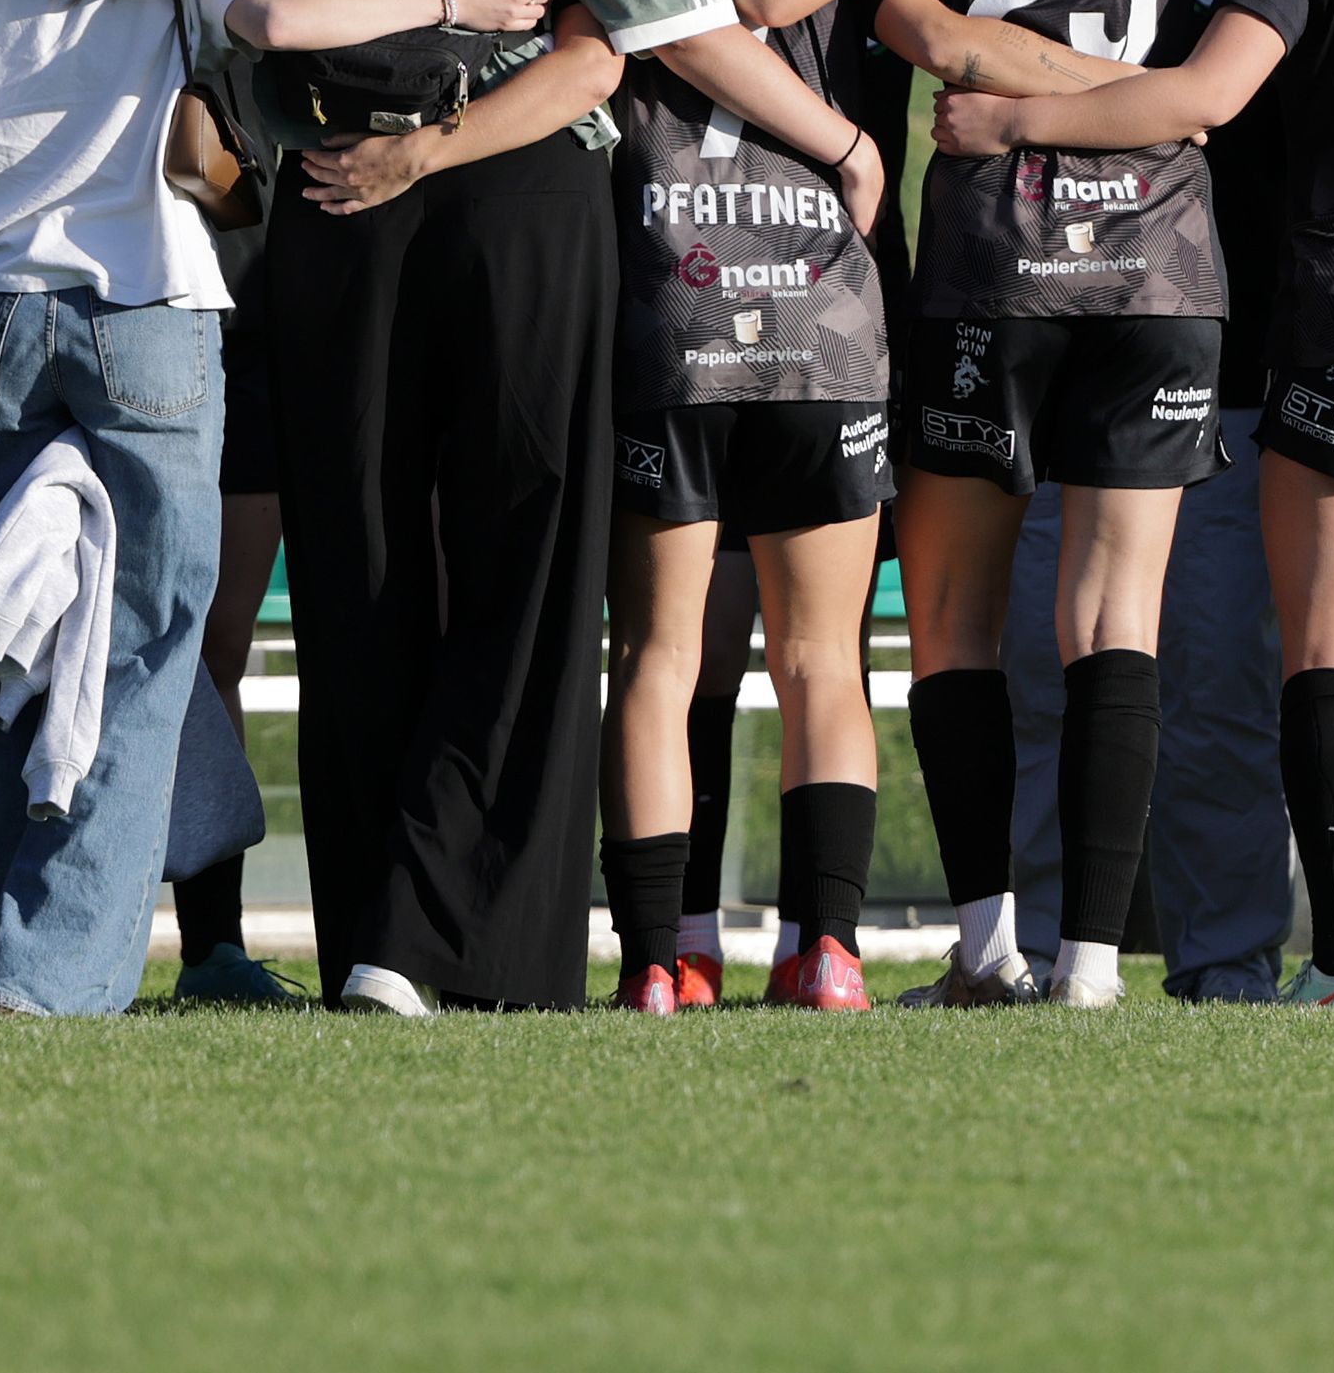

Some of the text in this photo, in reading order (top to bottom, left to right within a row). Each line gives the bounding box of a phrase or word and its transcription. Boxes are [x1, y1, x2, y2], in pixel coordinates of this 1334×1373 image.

[642, 182, 843, 234] PFATTNER
[1102, 201, 1138, 211] bekannt
[722, 290, 738, 299] Für
[772, 289, 809, 298] bekannt
[684, 347, 814, 368] PapierService
[926, 413, 1010, 455] STYX
[923, 434, 1014, 470] NATURCOSMETIC
